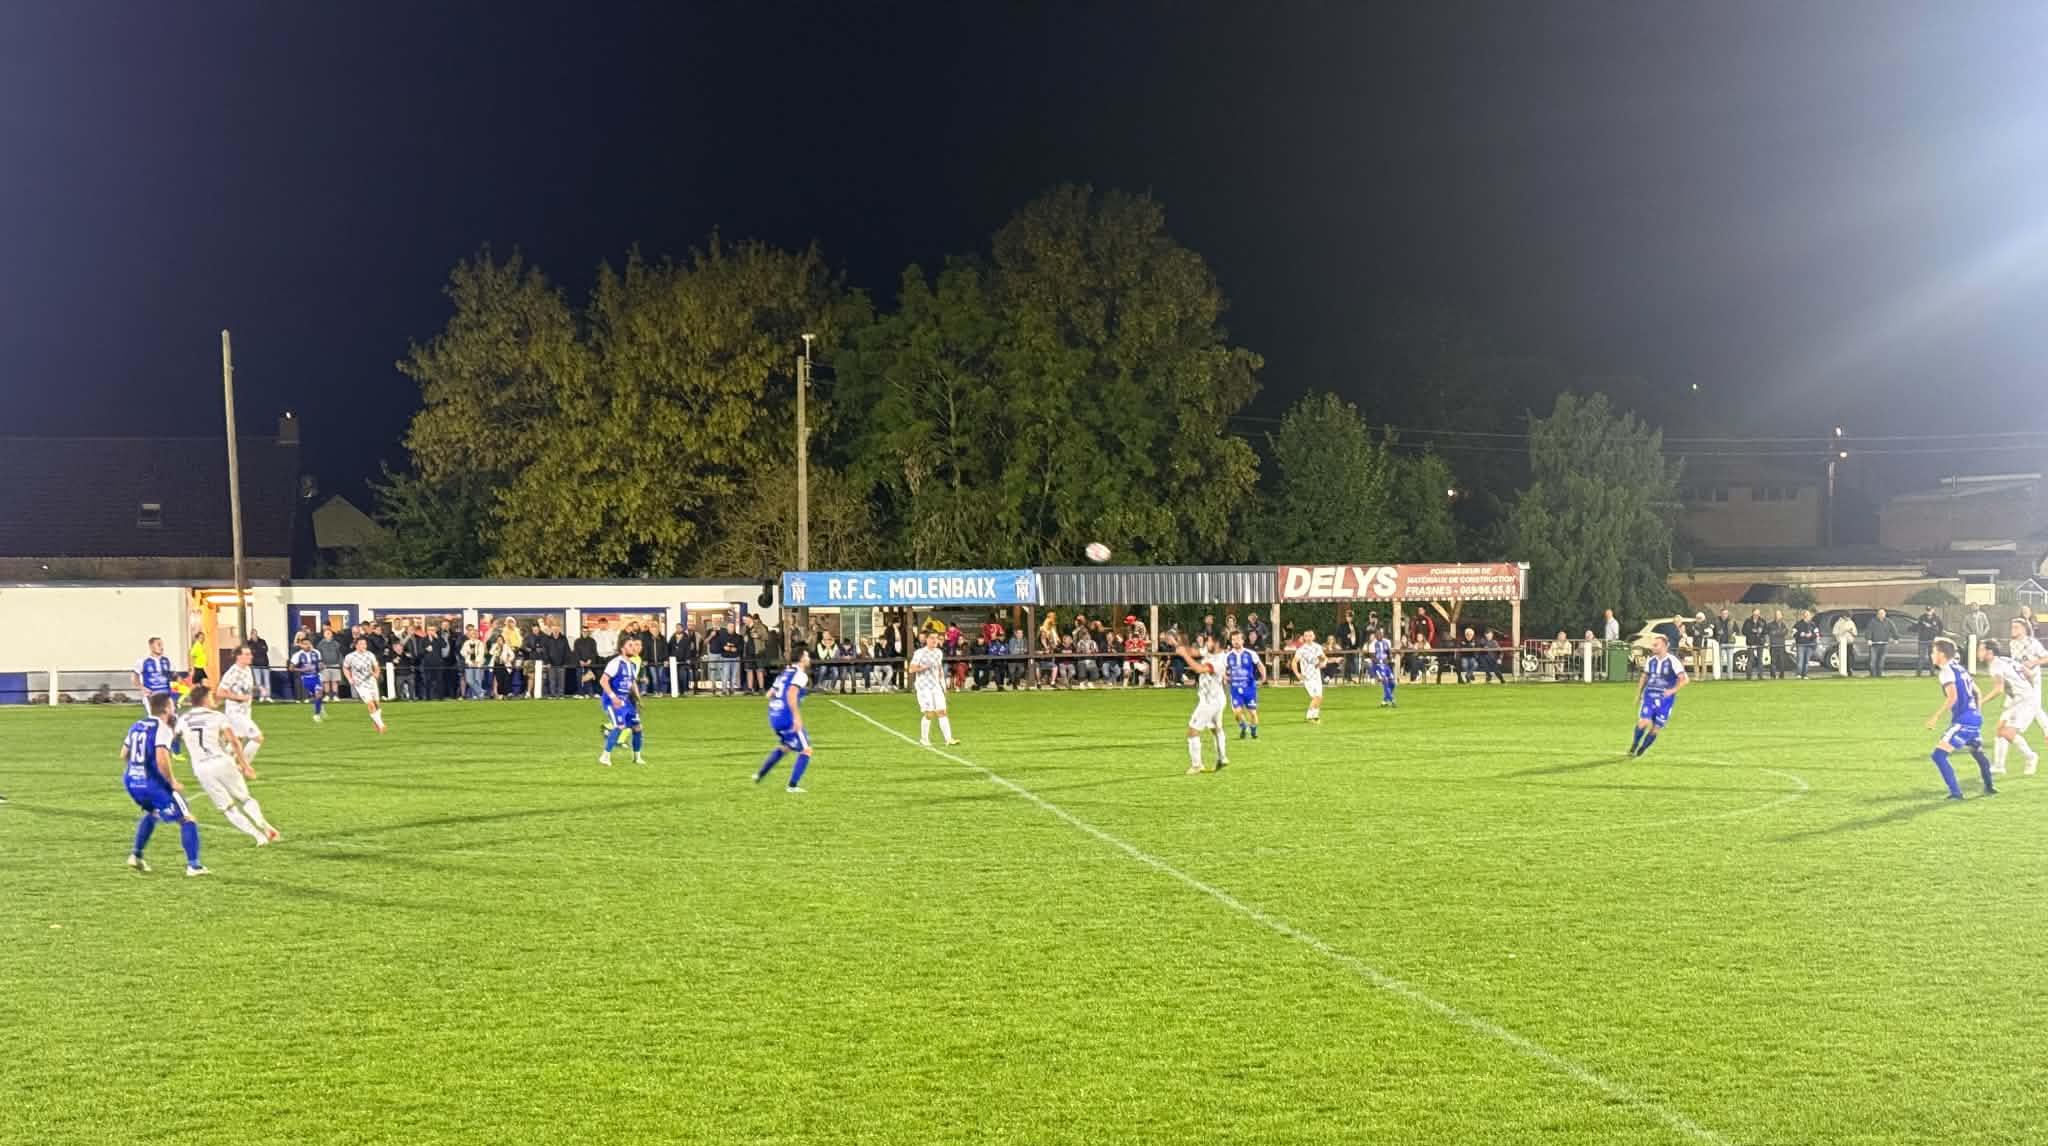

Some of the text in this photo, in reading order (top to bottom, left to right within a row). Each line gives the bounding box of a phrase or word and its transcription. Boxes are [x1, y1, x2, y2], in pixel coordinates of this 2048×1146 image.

[829, 578, 881, 600] R.F.C.
[889, 577, 997, 599] MOLENBAIX
[1284, 567, 1398, 597] DELYS
[1405, 585, 1452, 596] FRASNES
[1460, 575, 1514, 583] CONSTRUCTION
[130, 731, 147, 763] 13
[191, 727, 211, 755] 7
